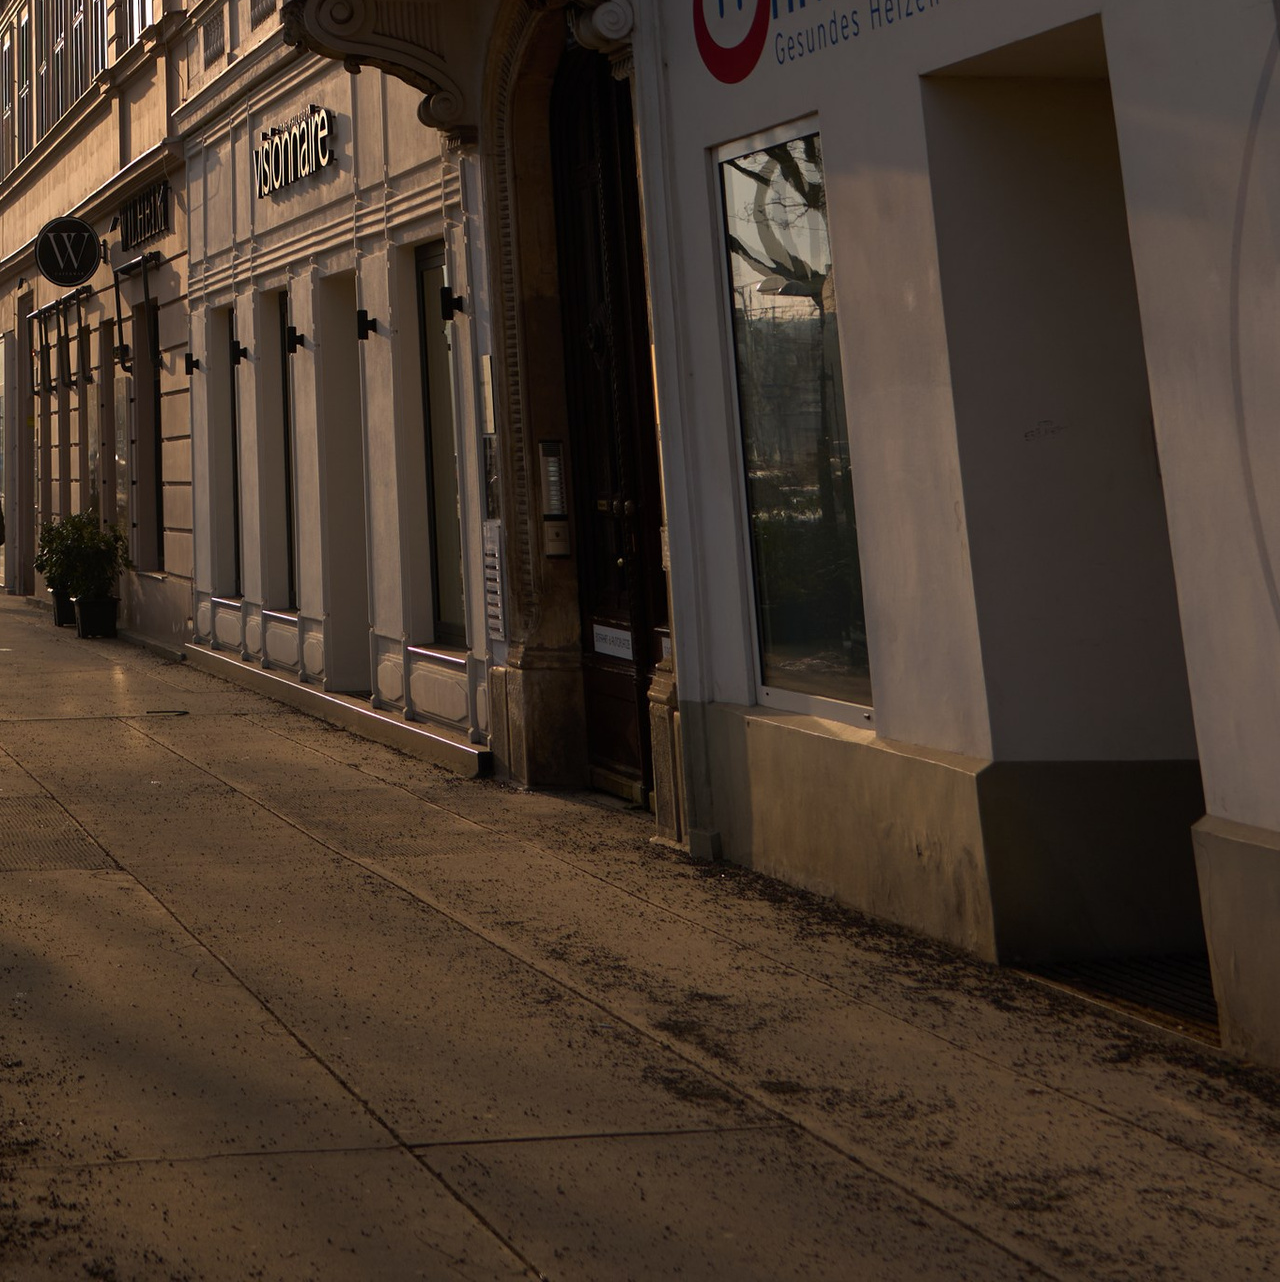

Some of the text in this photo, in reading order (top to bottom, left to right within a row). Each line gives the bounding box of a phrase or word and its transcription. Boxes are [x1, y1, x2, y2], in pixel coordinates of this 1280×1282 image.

[775, 9, 861, 65] Gesundes
[253, 104, 331, 199] visionnaire
[46, 233, 90, 270] W
